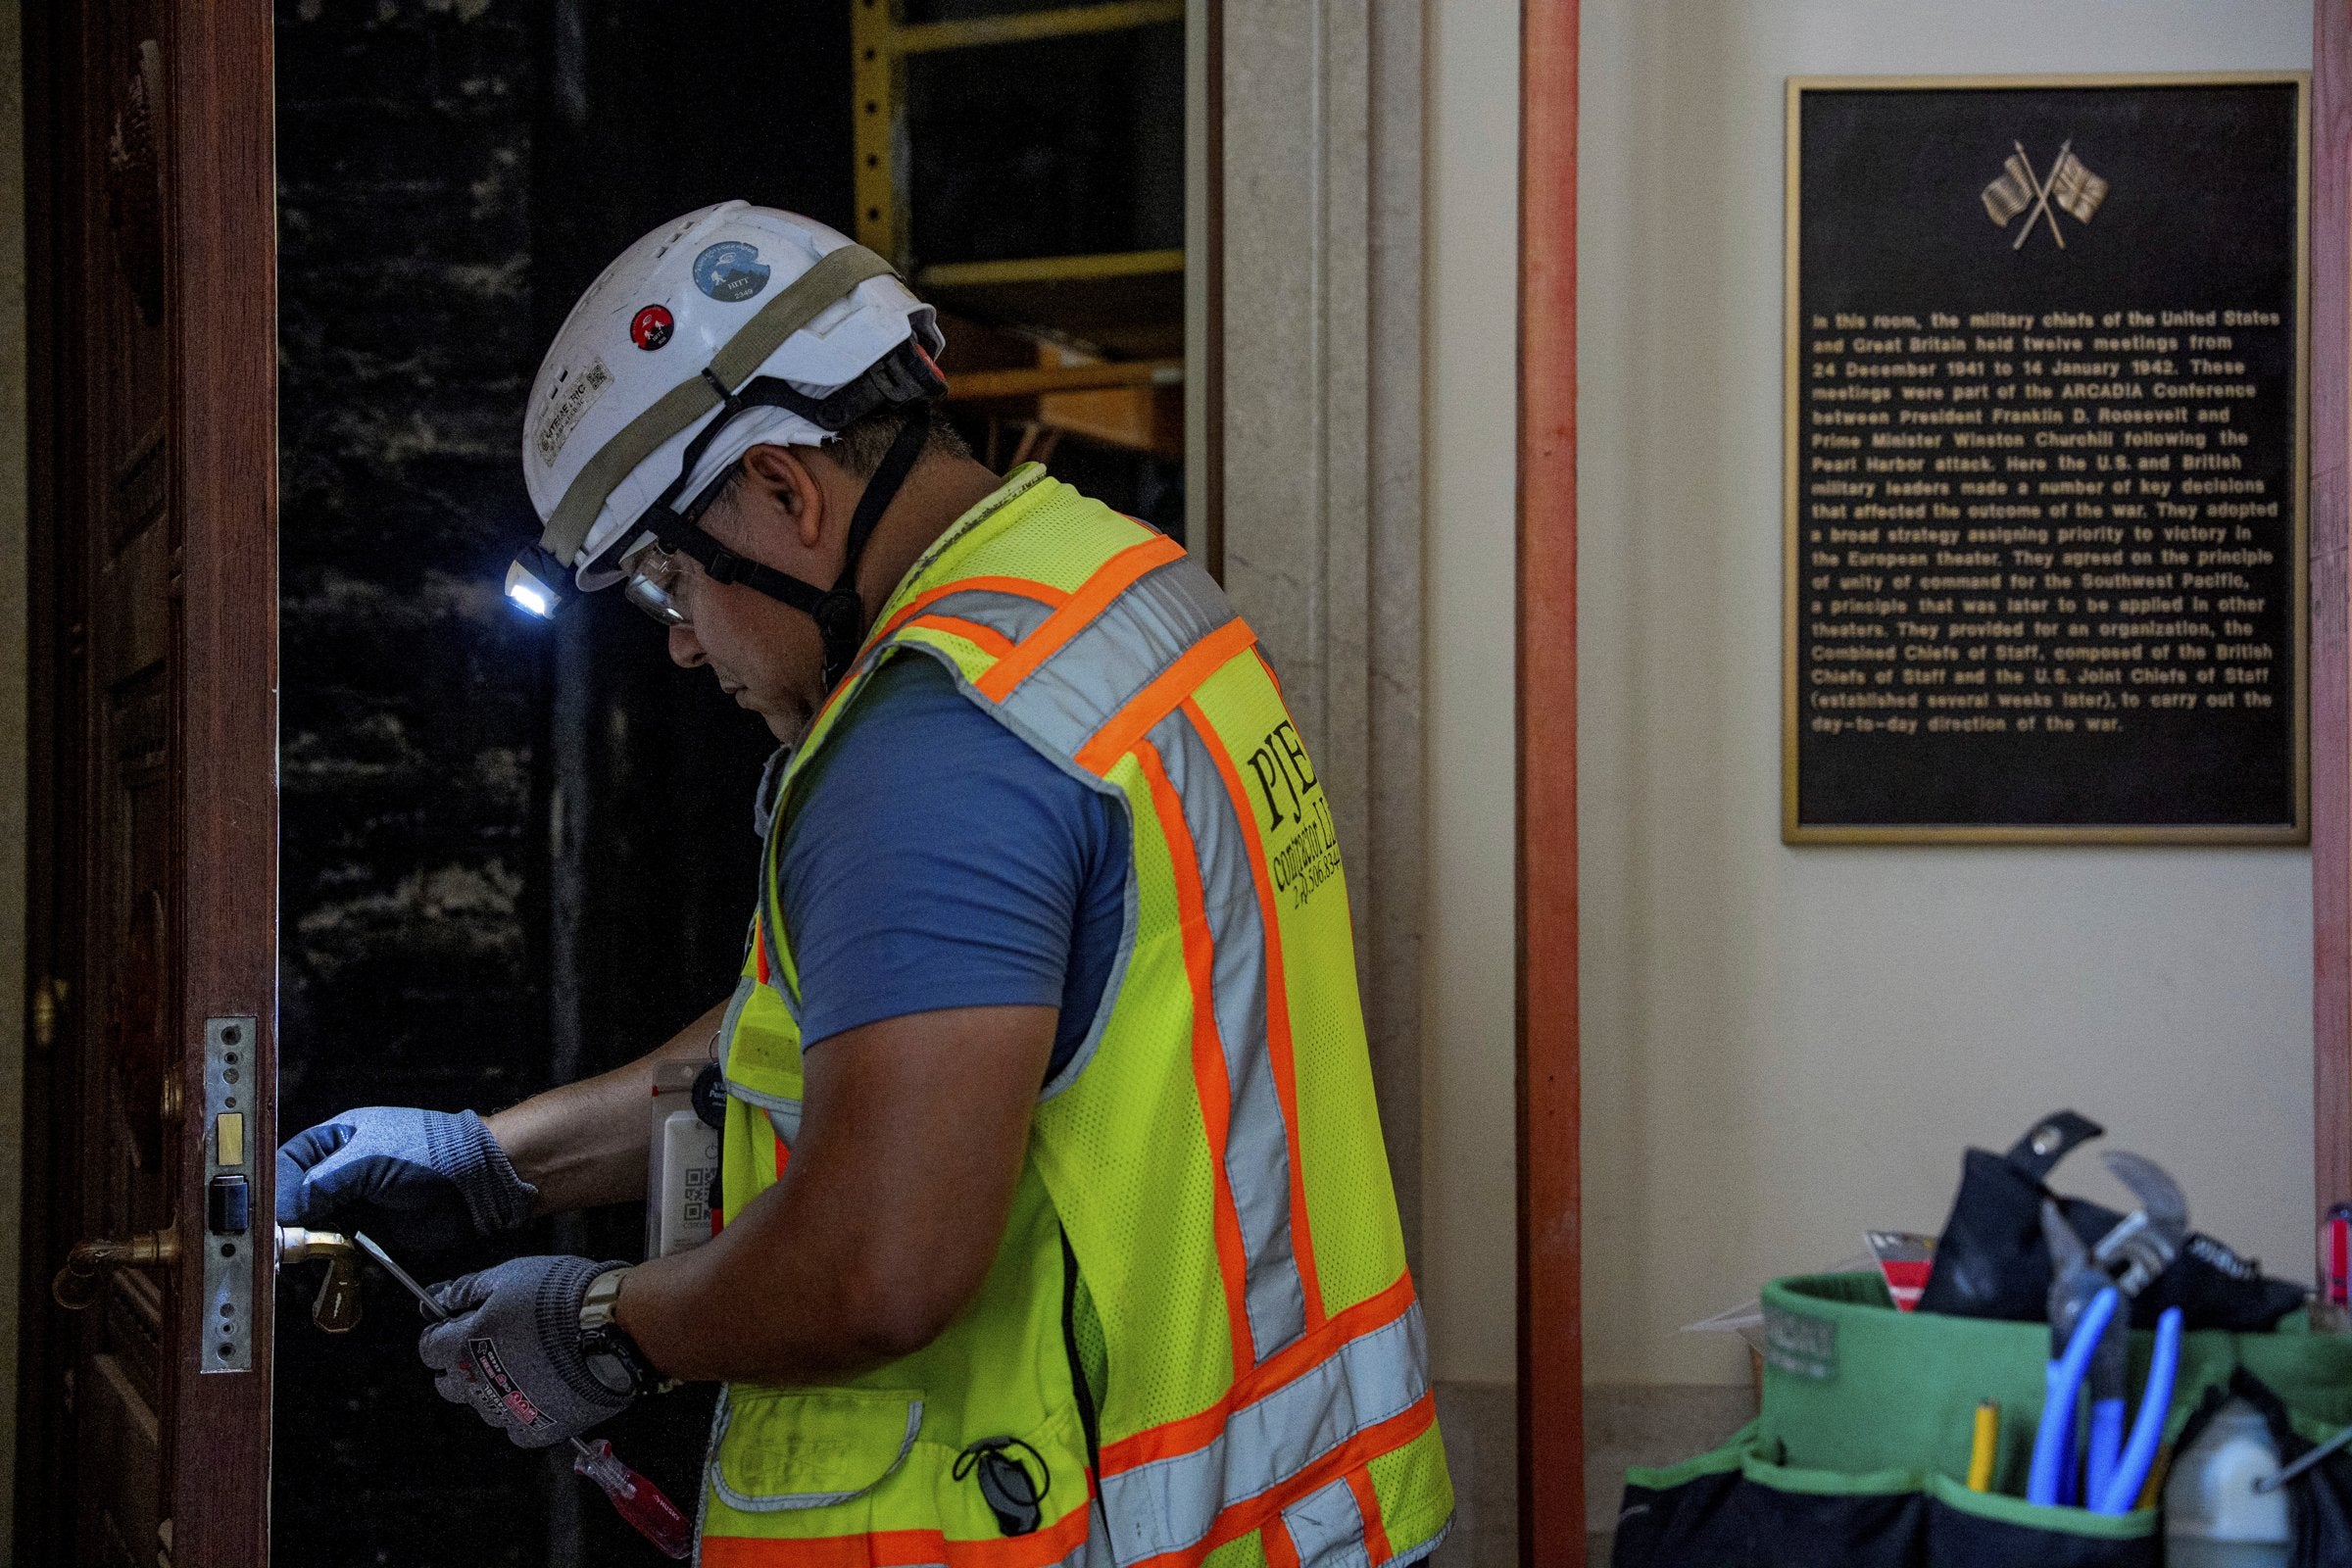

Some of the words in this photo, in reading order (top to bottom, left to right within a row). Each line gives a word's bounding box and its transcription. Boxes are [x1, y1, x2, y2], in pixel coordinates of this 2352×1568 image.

[1835, 313, 1867, 329] this
[1930, 312, 1960, 328] the
[1969, 312, 2034, 331] military
[2041, 311, 2095, 328] chiefs
[2101, 311, 2123, 328] of
[2127, 311, 2156, 327] the
[2160, 310, 2217, 327] United
[2222, 310, 2279, 326] States
[1813, 338, 1844, 354] and
[1852, 337, 1902, 354] Great
[1909, 336, 1967, 353] Britain
[1975, 335, 2014, 353] held
[2022, 335, 2083, 352] twelve
[2092, 334, 2179, 354] meetings
[2188, 334, 2233, 350] from
[1845, 361, 1936, 378] December
[1946, 361, 1984, 376] 1941
[1993, 361, 2013, 376] to
[2023, 360, 2043, 375] 14
[2051, 360, 2121, 378] January
[2189, 358, 2246, 375] These
[1812, 384, 1891, 404] meetings
[1900, 386, 1944, 401] were
[1952, 384, 1989, 402] part
[1996, 383, 2016, 400] of
[2024, 383, 2053, 400] the
[2061, 382, 2143, 399] ARCADIA
[2152, 382, 2257, 399] Conference
[1812, 409, 1890, 425] between
[1899, 408, 1983, 424] President
[1991, 408, 2064, 424] Franklin
[2097, 407, 2188, 423] Roosevelt
[2196, 407, 2230, 423] and
[1812, 433, 1862, 449] Prime
[1871, 432, 1942, 448] Minister
[1953, 431, 2025, 448] Winston
[2034, 430, 2114, 448] Churchill
[2124, 430, 2207, 449] following
[2219, 429, 2249, 446] the
[1812, 457, 1857, 472] Pearl
[1865, 456, 1925, 472] Harbor
[2005, 456, 2047, 471] Here
[2057, 454, 2087, 471] the
[2136, 455, 2171, 471] and
[2181, 453, 2242, 470] British
[1811, 479, 1876, 498] military
[1886, 480, 1950, 496] leaders
[1960, 479, 2008, 496] made
[2017, 481, 2030, 496] a
[2038, 479, 2104, 495] number
[2111, 478, 2132, 495] of
[2139, 478, 2172, 498] key
[2180, 477, 2265, 495] decisions
[1811, 503, 1847, 519] that
[1853, 503, 1927, 519] affected
[1932, 503, 1961, 519] the
[1967, 503, 2042, 519] outcome
[2048, 502, 2069, 518] of
[2075, 502, 2104, 518] the
[2155, 501, 2198, 520] They
[2206, 502, 2278, 519] adopted
[1810, 529, 1822, 542] a
[1830, 527, 1880, 544] broad
[1886, 526, 1960, 546] strategy
[1967, 525, 2049, 545] assigning
[2057, 525, 2124, 544] priority
[2133, 525, 2154, 542] to
[2163, 525, 2227, 544] victory
[2234, 525, 2252, 540] in
[1812, 551, 1839, 566] the
[1847, 551, 1929, 568] European
[2012, 550, 2054, 568] They
[2062, 549, 2124, 567] agreed
[2130, 551, 2153, 565] on
[2160, 549, 2189, 564] the
[2197, 548, 2274, 567] principle
[1812, 574, 1830, 590] of
[1839, 574, 1884, 592] unity
[1891, 574, 1912, 590] of
[1919, 573, 2002, 590] command
[2009, 573, 2036, 589] for
[2043, 573, 2073, 589] the
[2081, 572, 2174, 589] Southwest
[1811, 601, 1823, 613] a
[1830, 598, 1908, 616] principle
[1918, 597, 1953, 613] that
[1962, 600, 1997, 613] was
[2006, 597, 2049, 613] later
[2057, 597, 2077, 612] to
[2085, 597, 2110, 613] be
[2118, 596, 2183, 615] applied
[2192, 596, 2209, 612] in
[2217, 596, 2265, 612] other
[1896, 621, 1939, 640] They
[1948, 620, 2025, 639] provided
[2034, 621, 2059, 637] for
[2068, 623, 2089, 637] an
[2224, 619, 2253, 636] the
[1811, 645, 1897, 662] Combined
[1903, 644, 1959, 661] Chiefs
[1967, 645, 1987, 661] of
[2053, 643, 2143, 662] composed
[2150, 644, 2171, 661] of
[2178, 643, 2207, 660] the
[2216, 643, 2273, 661] British
[1811, 668, 1866, 685] Chiefs
[1875, 668, 1893, 684] of
[1902, 668, 1946, 684] Staff
[1953, 668, 1986, 684] and
[1995, 668, 2025, 684] the
[2078, 667, 2122, 684] Joint
[2130, 667, 2187, 684] Chiefs
[2195, 667, 2216, 683] of
[2224, 667, 2269, 684] Staff
[1811, 691, 1919, 709] (established
[1927, 693, 1989, 709] several
[1996, 692, 2053, 708] weeks
[2121, 691, 2140, 708] to
[2149, 693, 2197, 710] carry
[2205, 692, 2235, 708] out
[2243, 691, 2273, 708] the
[1927, 715, 2006, 732] direction
[2016, 715, 2036, 732] of
[2045, 715, 2076, 732] the
[1247, 719, 1318, 833] PJE
